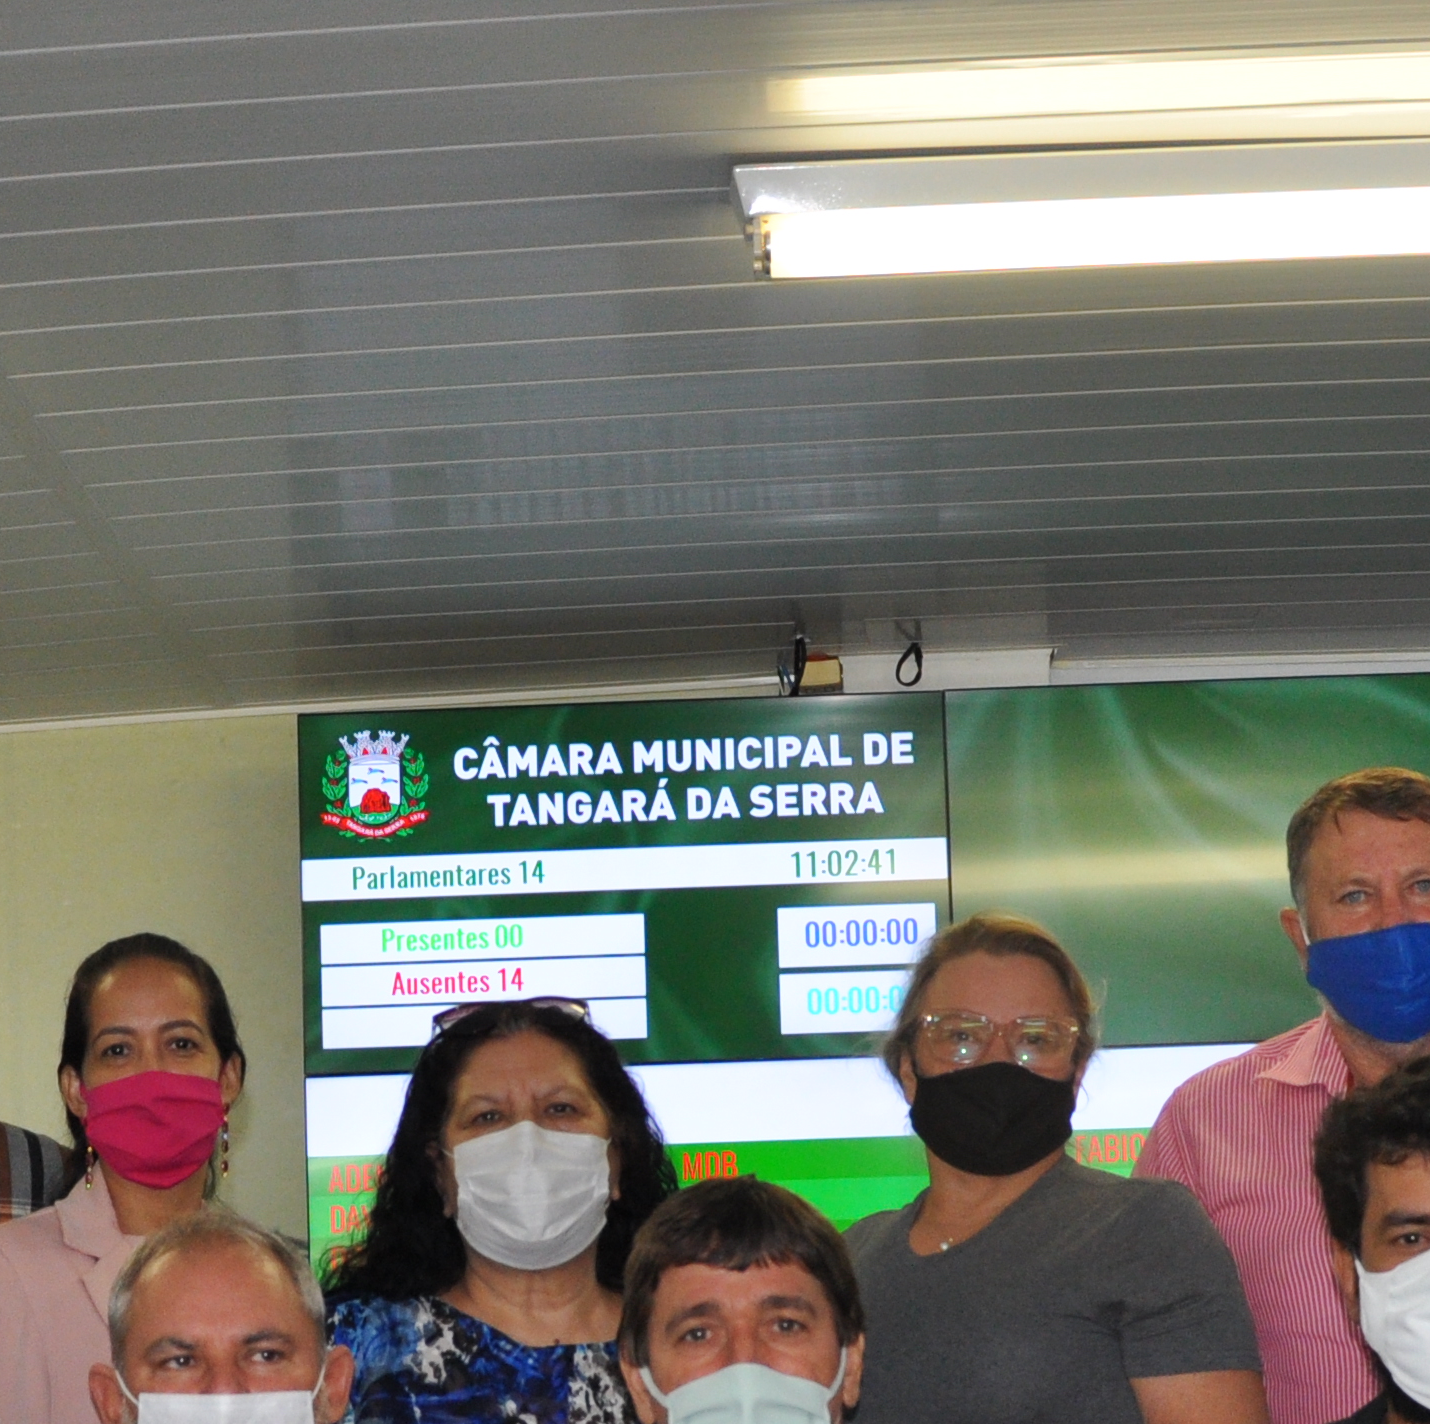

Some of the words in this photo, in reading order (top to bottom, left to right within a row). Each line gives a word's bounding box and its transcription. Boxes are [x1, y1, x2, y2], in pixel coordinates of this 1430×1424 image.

[453, 735, 623, 780] CÂMARA
[633, 734, 853, 774] MUNICIPAL
[863, 731, 914, 766] DE
[486, 778, 677, 827] TANGARÁ
[686, 786, 741, 820] DA
[749, 781, 885, 818] SERRA
[352, 864, 511, 891] Parlamentares
[519, 860, 545, 884] 14
[791, 848, 896, 878] 11:02:41
[382, 928, 489, 952] Presentes
[495, 924, 523, 949] 00
[805, 917, 918, 948] 00:00:00
[392, 971, 490, 996] Ausentes
[497, 967, 524, 992] 14
[807, 985, 905, 1015] 00:00:0
[682, 1150, 739, 1180] MDB
